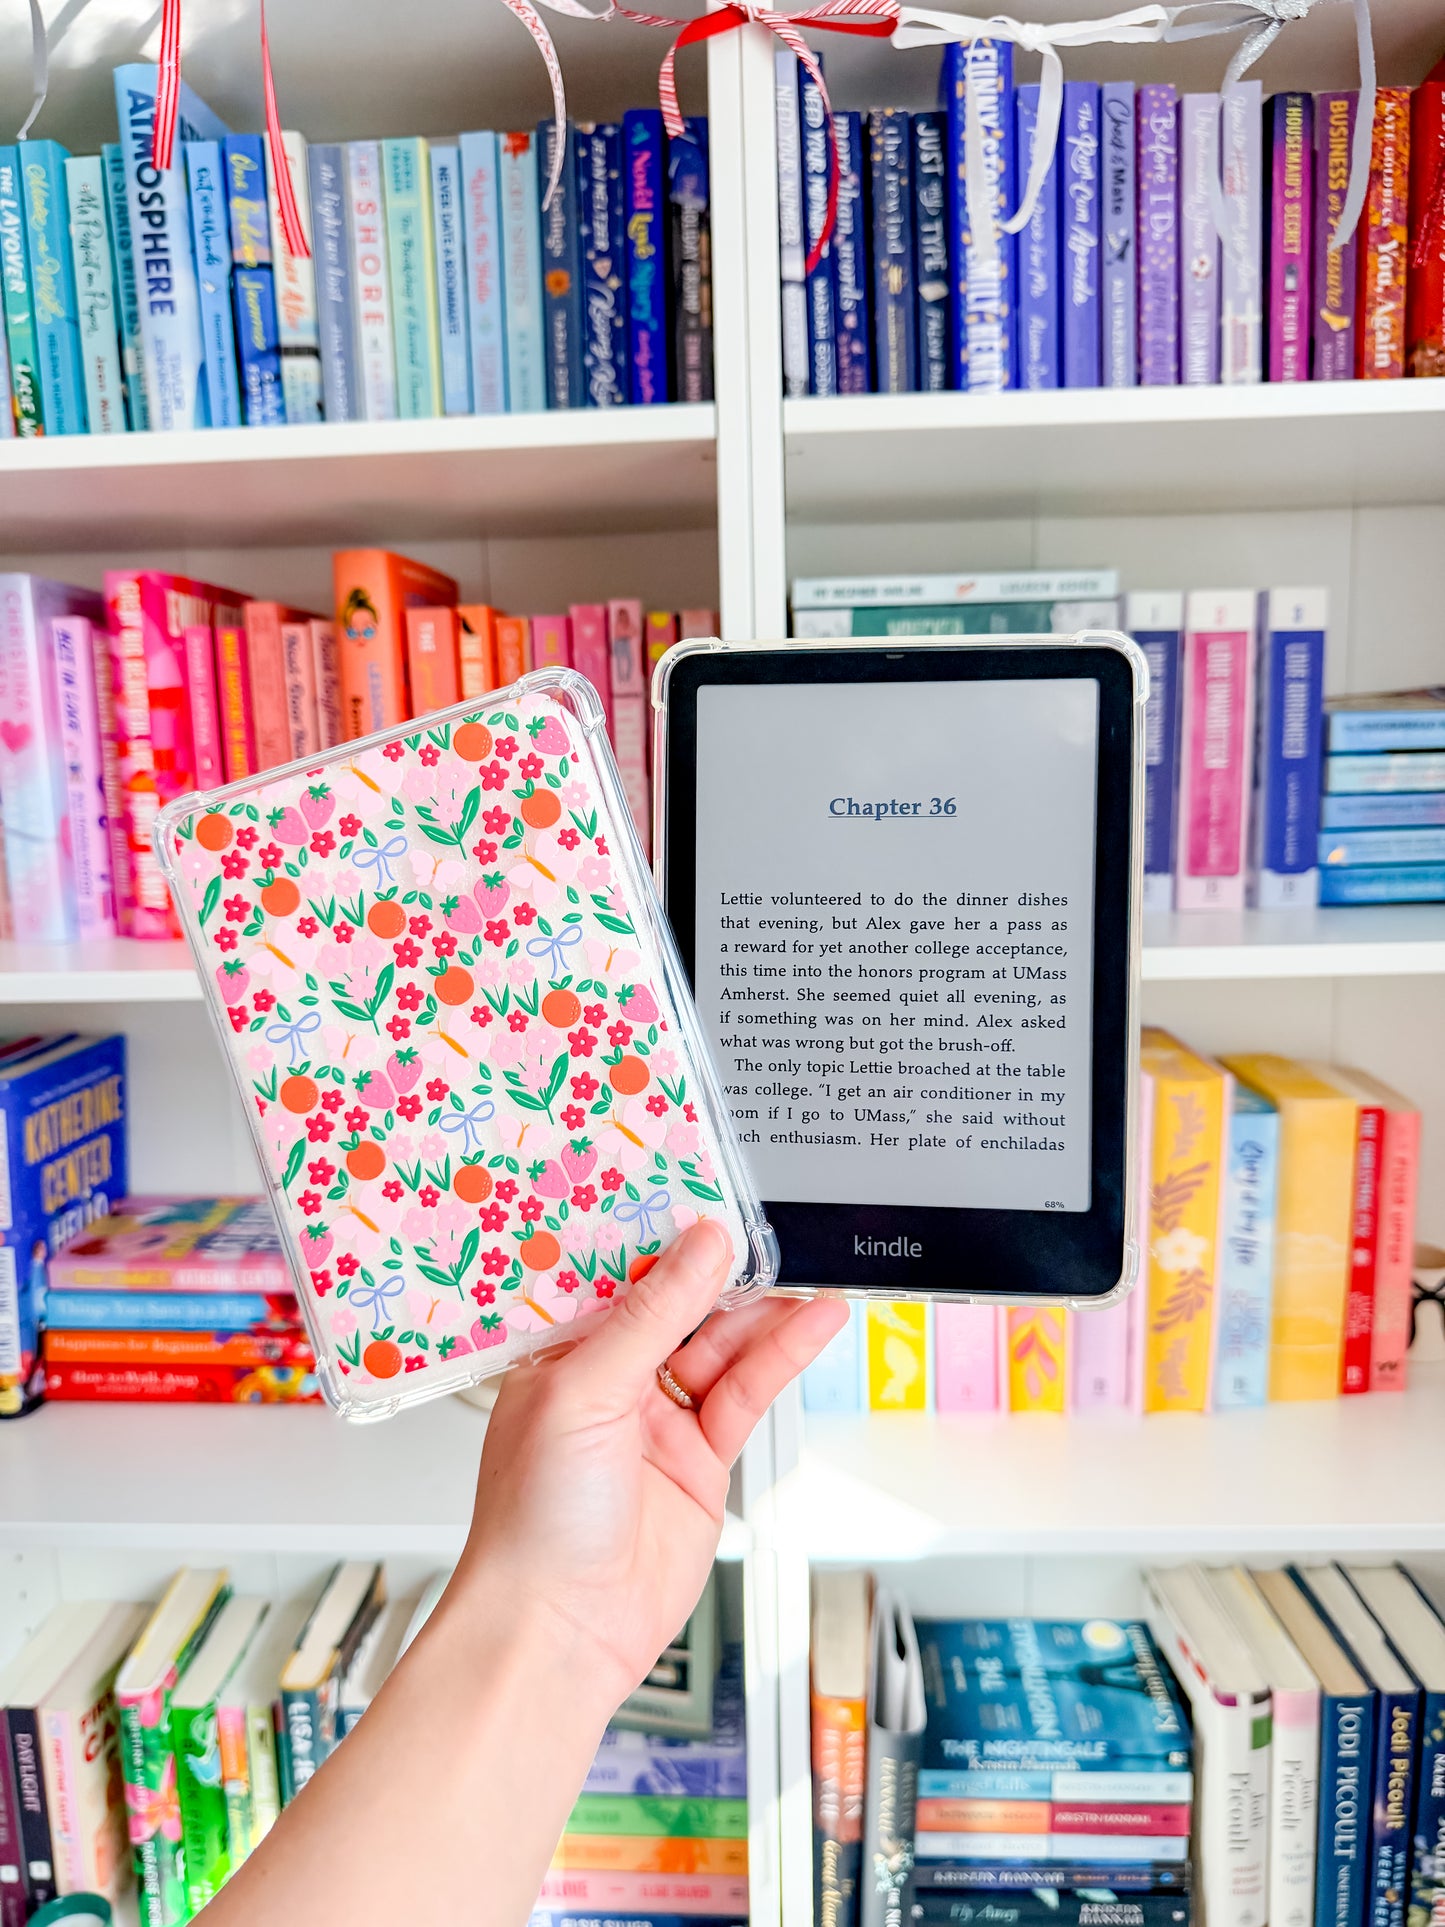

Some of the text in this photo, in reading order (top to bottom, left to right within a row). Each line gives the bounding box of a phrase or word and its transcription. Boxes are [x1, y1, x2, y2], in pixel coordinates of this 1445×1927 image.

[803, 83, 826, 173] NEED YOUR
[1077, 102, 1093, 130] The
[230, 153, 258, 191] One
[591, 137, 608, 181] JEAN
[918, 122, 943, 176] JUST
[1150, 110, 1175, 184] Before
[1328, 100, 1348, 213] BUSINESS or
[1381, 101, 1396, 227] KATE GOLDBECK
[320, 163, 335, 188] the
[438, 167, 451, 208] NEVER
[632, 151, 654, 210] Novel
[885, 126, 905, 254] the rewind
[1110, 169, 1126, 215] Mate
[1149, 192, 1171, 204] I
[1283, 107, 1302, 255] HOUSEMAID'S SECRET
[127, 89, 175, 316] ATMOSPHERE
[836, 181, 860, 236] than
[0, 166, 27, 293] THE LAYOVER
[355, 155, 384, 326] THE SHORE
[441, 214, 453, 243] DATE
[627, 212, 656, 260] Love
[920, 220, 945, 272] TYPE
[838, 240, 863, 311] words
[1069, 225, 1098, 307] Agenda
[445, 261, 460, 335] ROOMMATE
[1372, 239, 1398, 369] You, Again
[829, 797, 957, 821] Chapter 36
[721, 892, 1068, 906] Lettie volunteered to do the dinner dishes
[720, 940, 1067, 959] a reward for yet another college acceptance,
[721, 916, 1068, 934] that evening, but Alex gave her a pass as
[720, 963, 1066, 982] this time into the honors program at UMass
[720, 987, 1067, 1008] Amherst. She seemed quiet all evening, as
[719, 1010, 1066, 1029] if something was on her mind. Alex asked
[720, 1034, 1015, 1054] what was wrong but got the brush-off.
[734, 1058, 1065, 1077] The only topic Lettie broached at the table
[755, 1082, 812, 1100] college.
[838, 1086, 861, 1101] get
[867, 1089, 887, 1098] an
[894, 1086, 913, 1098] air
[921, 1086, 1011, 1100] conditioner
[1017, 1088, 1034, 1101] in
[1040, 1093, 1066, 1106] my
[767, 1106, 780, 1119] if
[787, 1107, 793, 1119] I
[801, 1111, 821, 1124] go
[829, 1109, 845, 1120] to
[926, 1110, 952, 1123] she
[962, 1112, 993, 1124] said
[1003, 1112, 1065, 1126] without
[25, 1073, 123, 1166] KATHERINE
[770, 1130, 860, 1145] enthusiasm.
[870, 1133, 899, 1146] Her
[908, 1134, 946, 1150] plate
[955, 1135, 972, 1148] of
[981, 1137, 1064, 1151] enchiladas
[42, 1133, 112, 1215] CENTER
[854, 1235, 922, 1257] kindle
[288, 1702, 313, 1754] LISA
[941, 1739, 1107, 1759] THE NIGHTINGALE
[15, 1733, 40, 1813] DAYLIGHT
[1334, 1703, 1364, 1860] JODI PICOULT
[1386, 1706, 1412, 1830] Jodi Picoult
[1280, 1760, 1302, 1831] Picoult
[1301, 1777, 1315, 1811] Jodi
